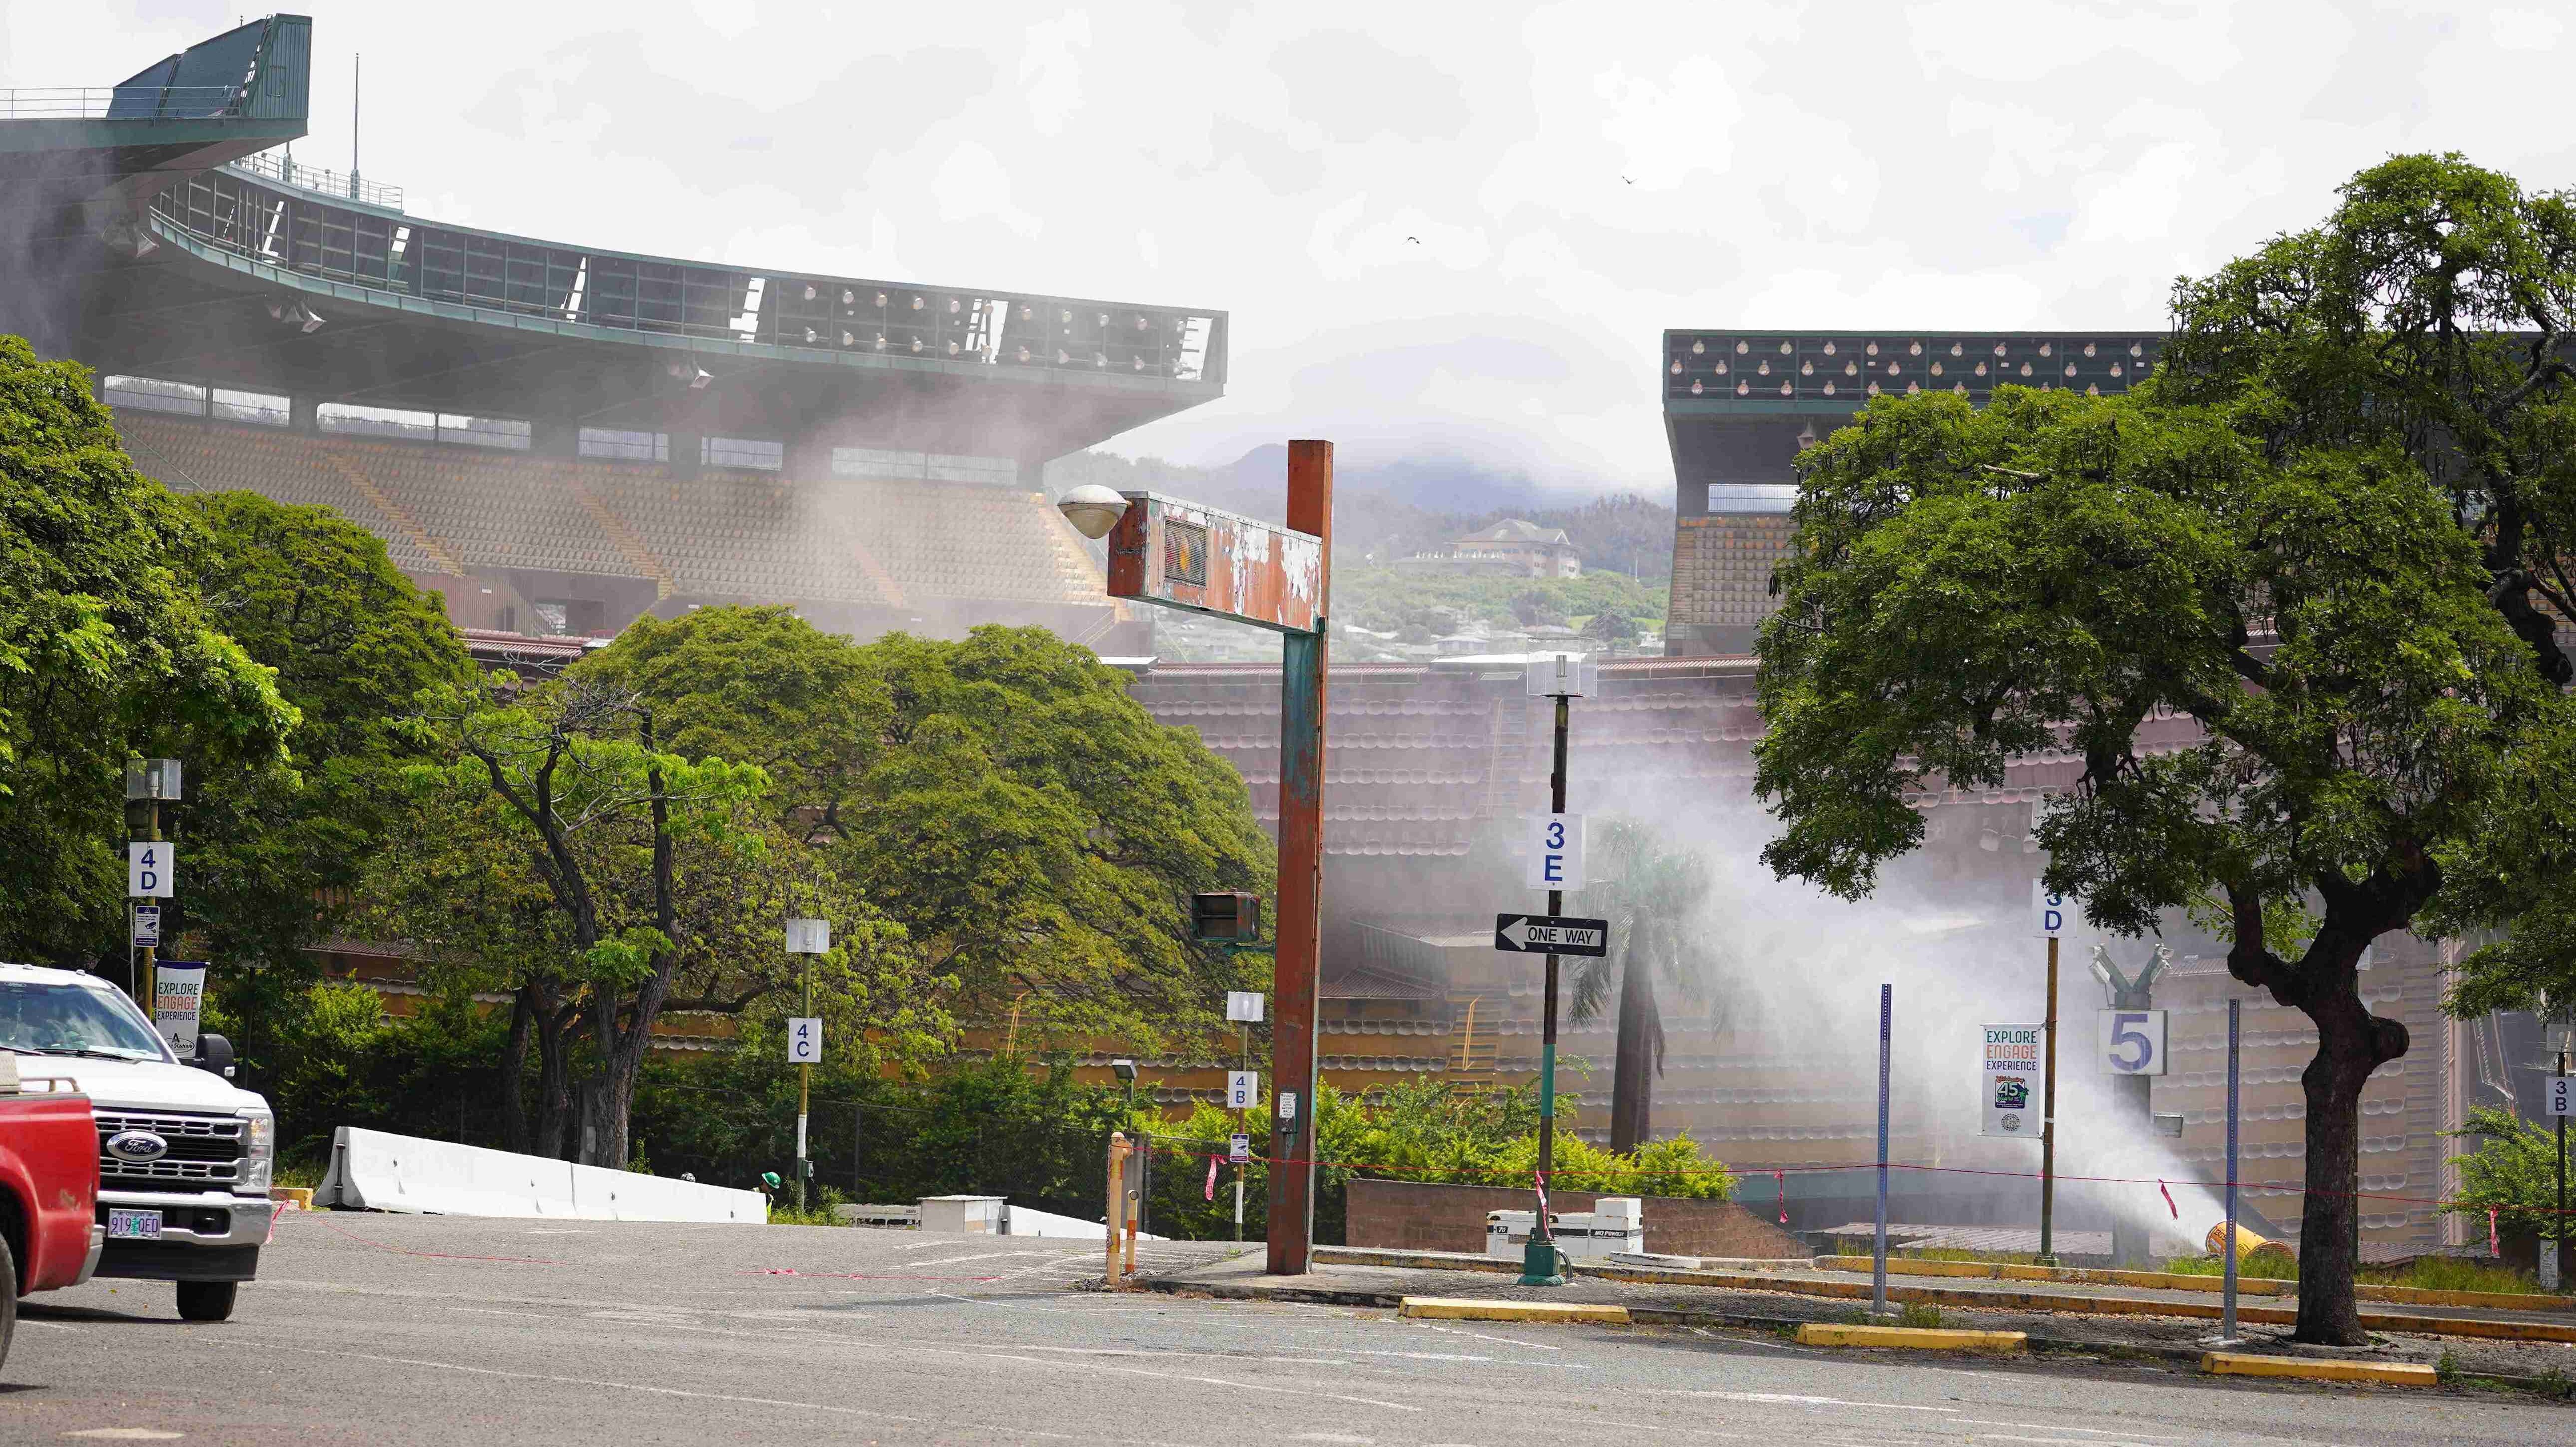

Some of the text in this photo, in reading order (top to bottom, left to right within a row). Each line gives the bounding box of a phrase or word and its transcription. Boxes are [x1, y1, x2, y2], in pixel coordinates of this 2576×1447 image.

[1546, 822, 1565, 849] 3
[141, 849, 156, 868] 4
[1545, 855, 1563, 881] E
[141, 871, 157, 890] D
[2045, 910, 2062, 930] D
[1528, 927, 1594, 944] ONE WAY
[159, 982, 199, 995] EXPLORE
[158, 995, 198, 1010] ENGAGE
[157, 1011, 196, 1020] EXPERIENCE
[797, 1024, 808, 1038] 4
[1987, 1031, 2037, 1043] EXPLORE
[797, 1041, 809, 1057] C
[2108, 1014, 2152, 1072] 5
[1987, 1045, 2037, 1059] ENGAGE
[1987, 1060, 2037, 1071] EXPERIENCE
[1236, 1076, 1246, 1086] 4
[2556, 1081, 2567, 1095] 3
[1997, 1082, 2018, 1097] 45
[1236, 1091, 1245, 1103] B
[2555, 1097, 2567, 1111] B
[125, 1139, 154, 1153] Ford
[112, 1217, 158, 1232] 919 QED
